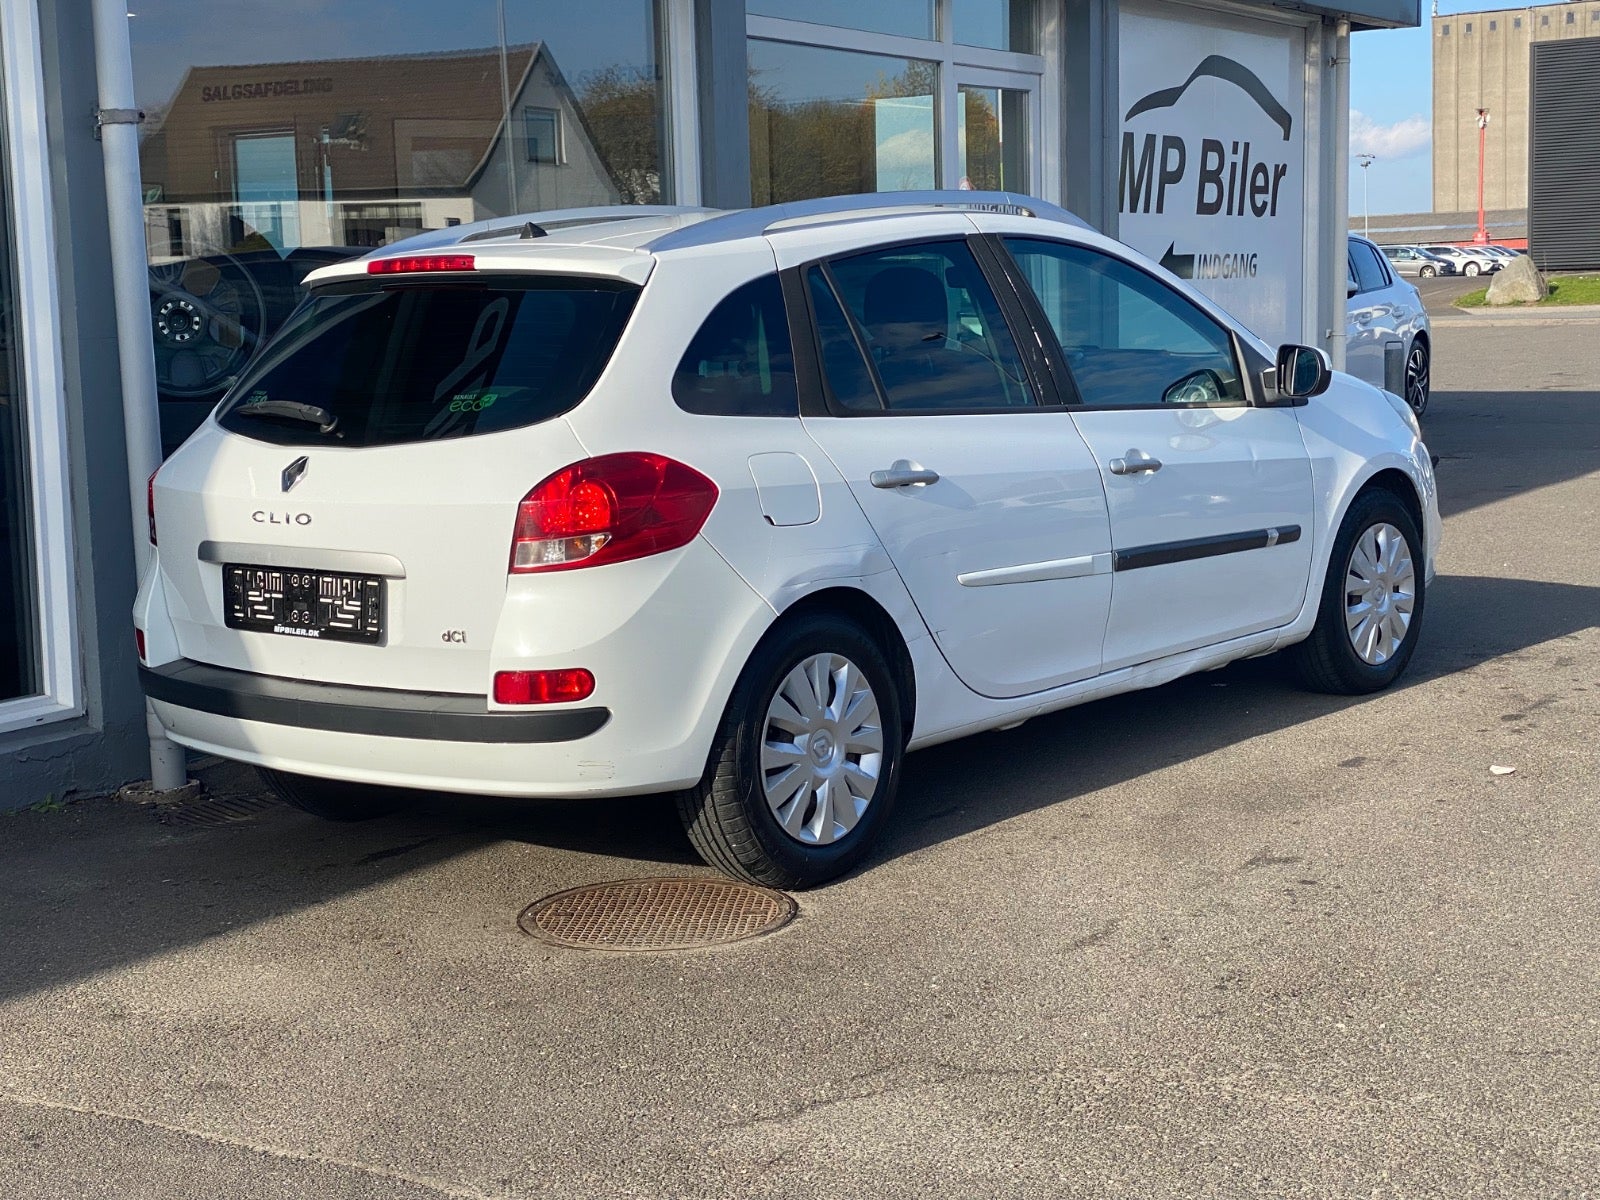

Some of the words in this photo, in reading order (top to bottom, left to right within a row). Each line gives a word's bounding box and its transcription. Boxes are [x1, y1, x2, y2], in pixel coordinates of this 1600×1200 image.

[202, 77, 333, 102] SALGSAFDELING
[1118, 131, 1186, 214] MP
[1196, 138, 1288, 218] Biler
[1197, 252, 1258, 280] INDGANG
[251, 510, 312, 526] CLIO
[441, 629, 466, 643] dCi
